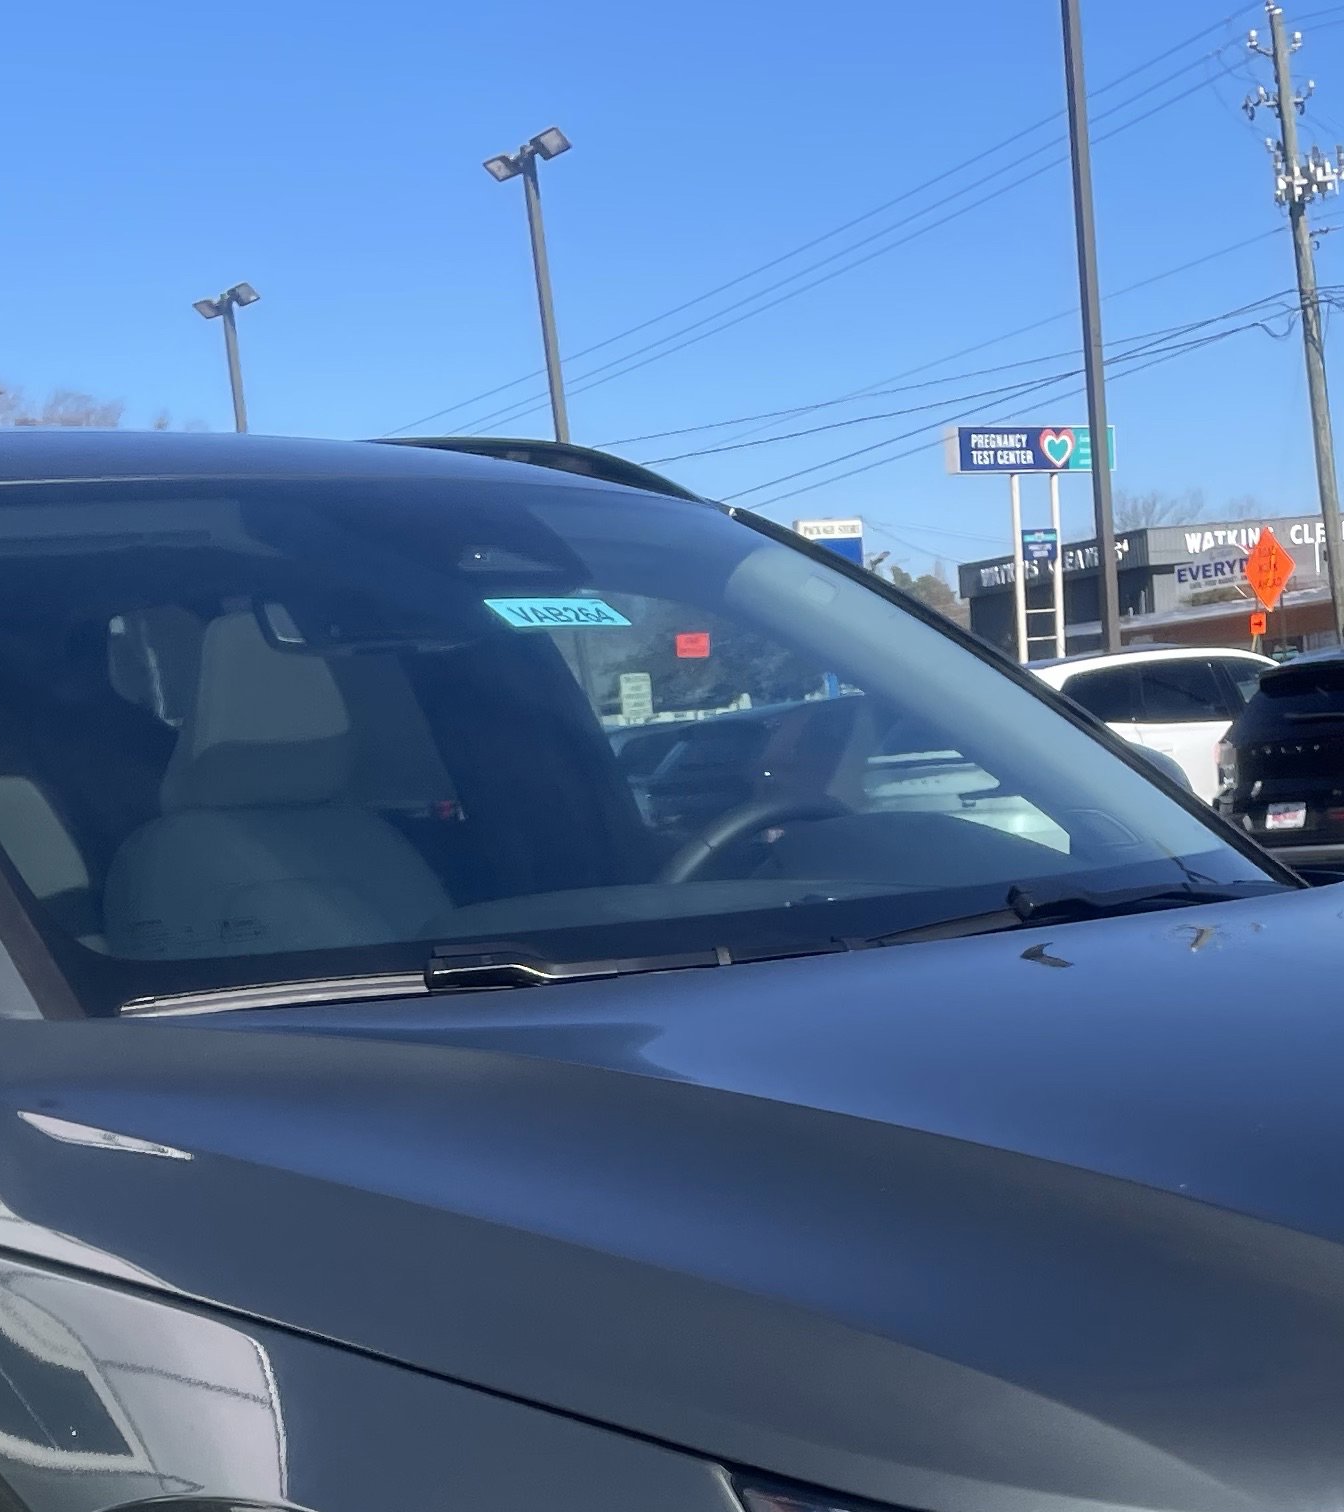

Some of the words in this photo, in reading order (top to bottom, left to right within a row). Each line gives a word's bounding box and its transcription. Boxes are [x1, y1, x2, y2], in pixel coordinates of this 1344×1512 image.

[970, 433, 1028, 449] PREGNANCY
[971, 451, 994, 465] TEST
[996, 450, 1034, 465] CENTER
[506, 606, 618, 623] VAB264
